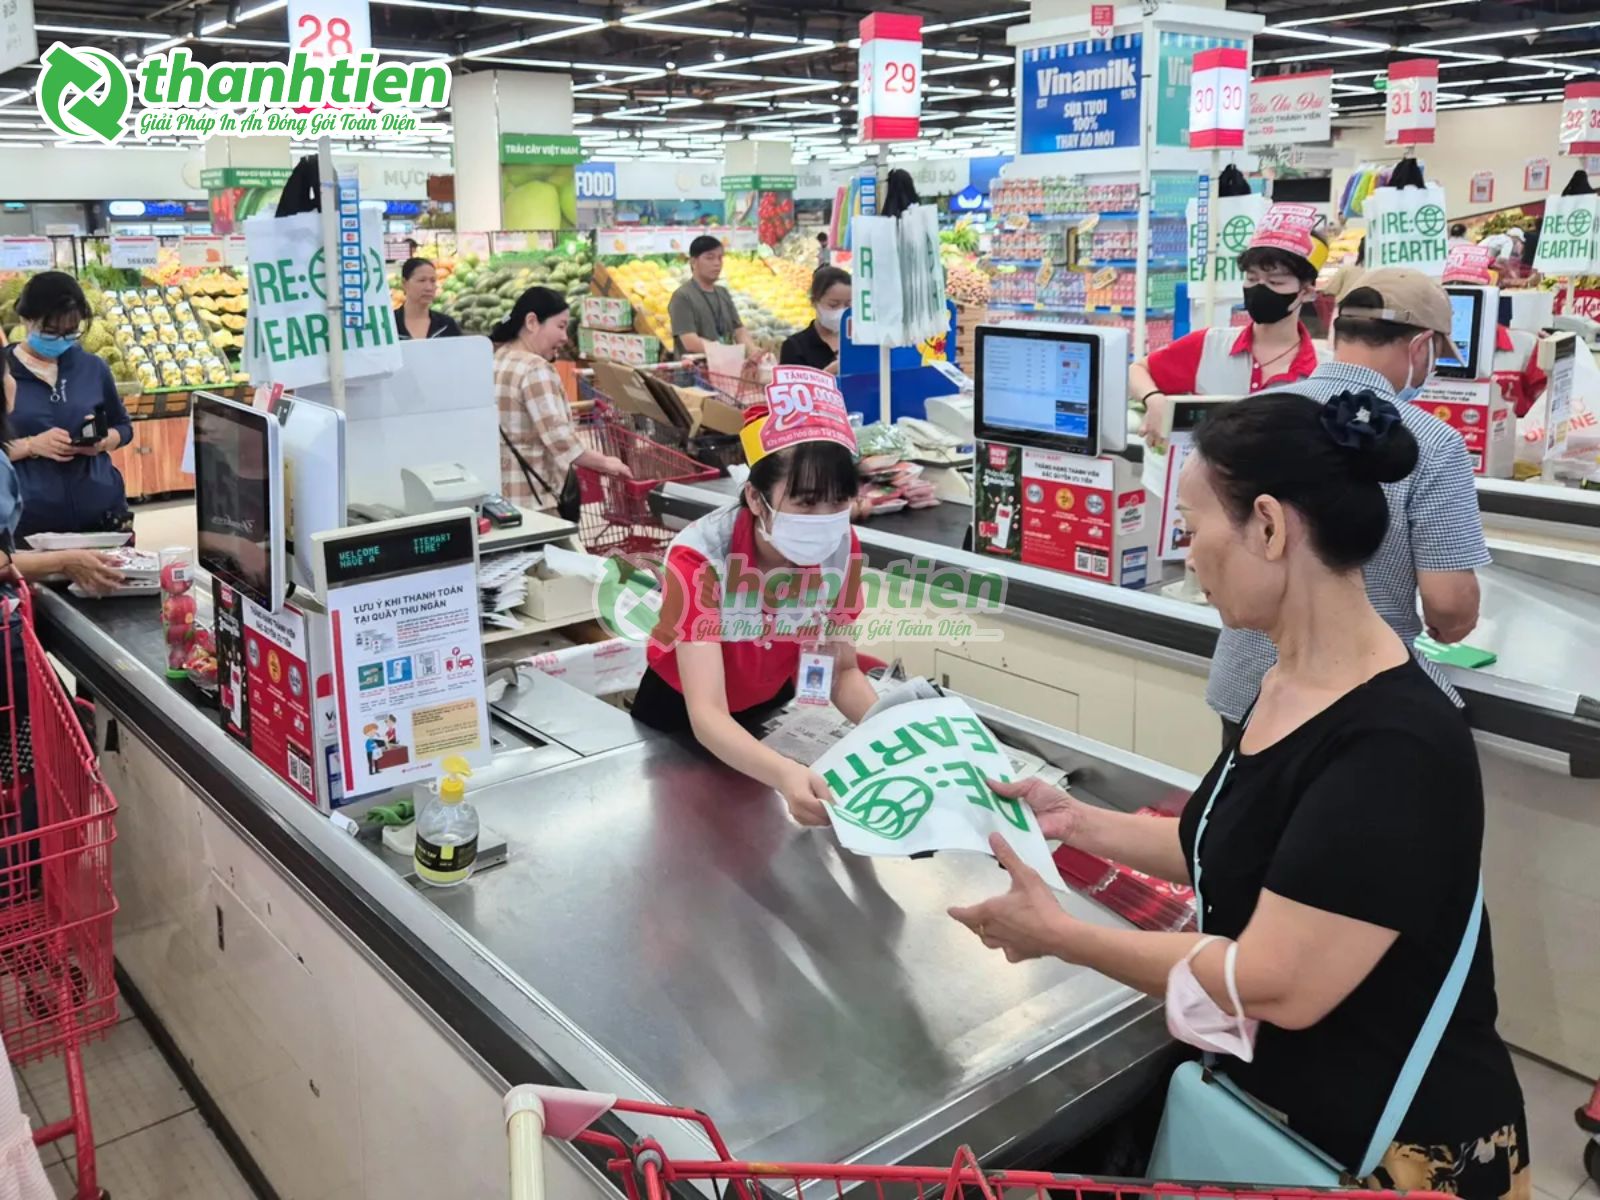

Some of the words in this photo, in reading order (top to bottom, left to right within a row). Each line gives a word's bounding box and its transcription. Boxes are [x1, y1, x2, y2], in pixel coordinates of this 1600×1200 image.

[884, 62, 915, 93] 29
[1037, 62, 1136, 97] Vinamilk
[1195, 87, 1214, 113] 30
[1223, 85, 1242, 110] 30
[1391, 91, 1412, 115] 31
[1419, 91, 1433, 113] 31
[1566, 111, 1583, 129] 32
[560, 146, 578, 155] NAM
[576, 171, 614, 196] FOOD
[1388, 238, 1447, 263] EARTH
[1541, 239, 1589, 260] EARTH
[254, 259, 310, 305] RE:
[339, 545, 380, 561] WELCOME
[340, 556, 363, 569] HAVE
[353, 601, 374, 614] LƯU
[385, 597, 402, 609] KHI
[403, 591, 436, 605] THANH
[437, 585, 464, 597] TOÁN
[354, 614, 371, 626] TẠI
[400, 605, 419, 617] THU
[420, 599, 447, 613] NGÂN
